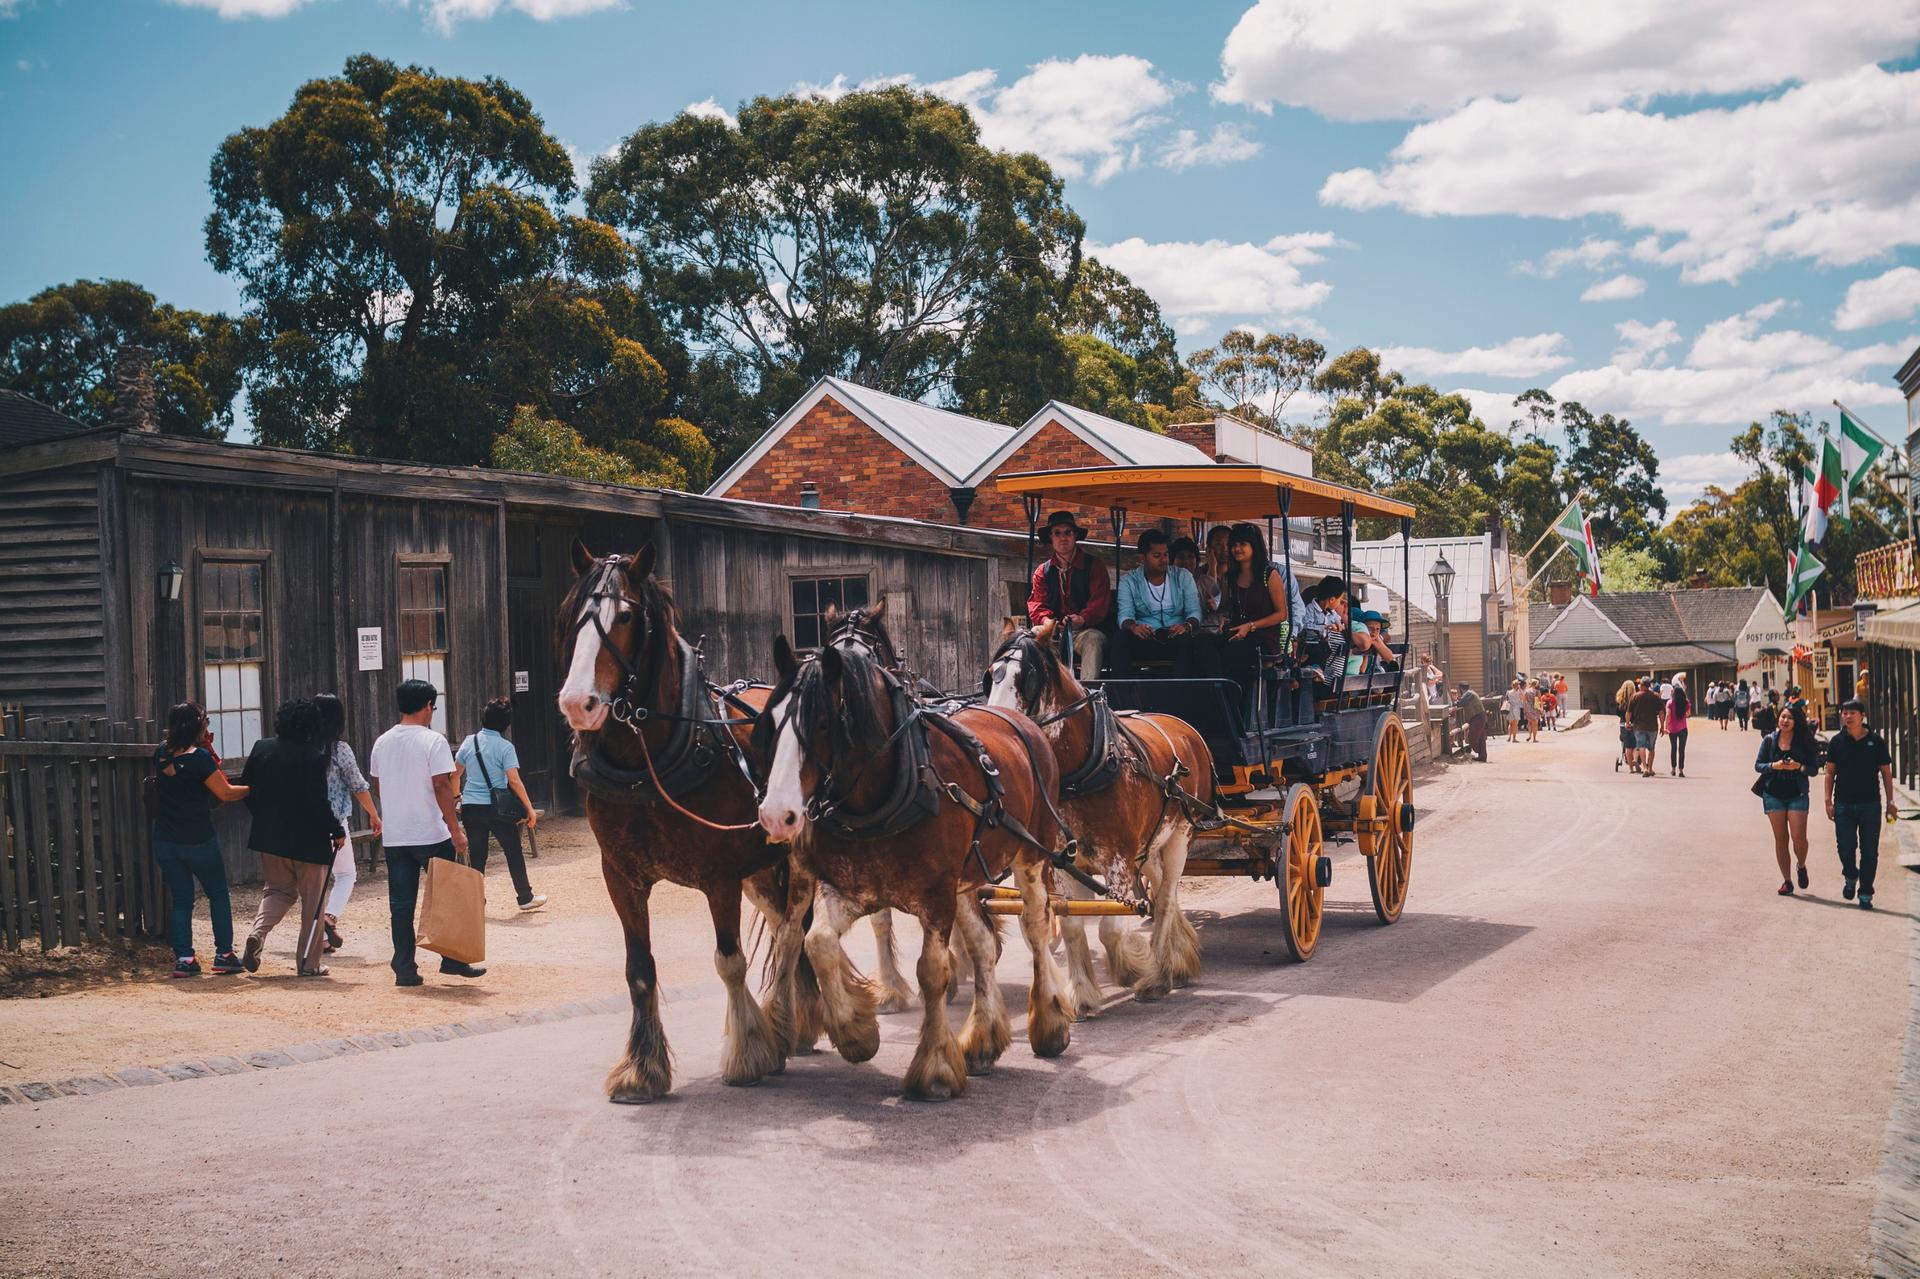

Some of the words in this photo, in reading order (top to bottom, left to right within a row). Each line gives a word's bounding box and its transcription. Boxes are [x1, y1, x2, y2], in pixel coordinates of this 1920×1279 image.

[1746, 633, 1762, 642] POST
[1765, 631, 1789, 641] OFFICE
[1822, 624, 1856, 638] GLASGO
